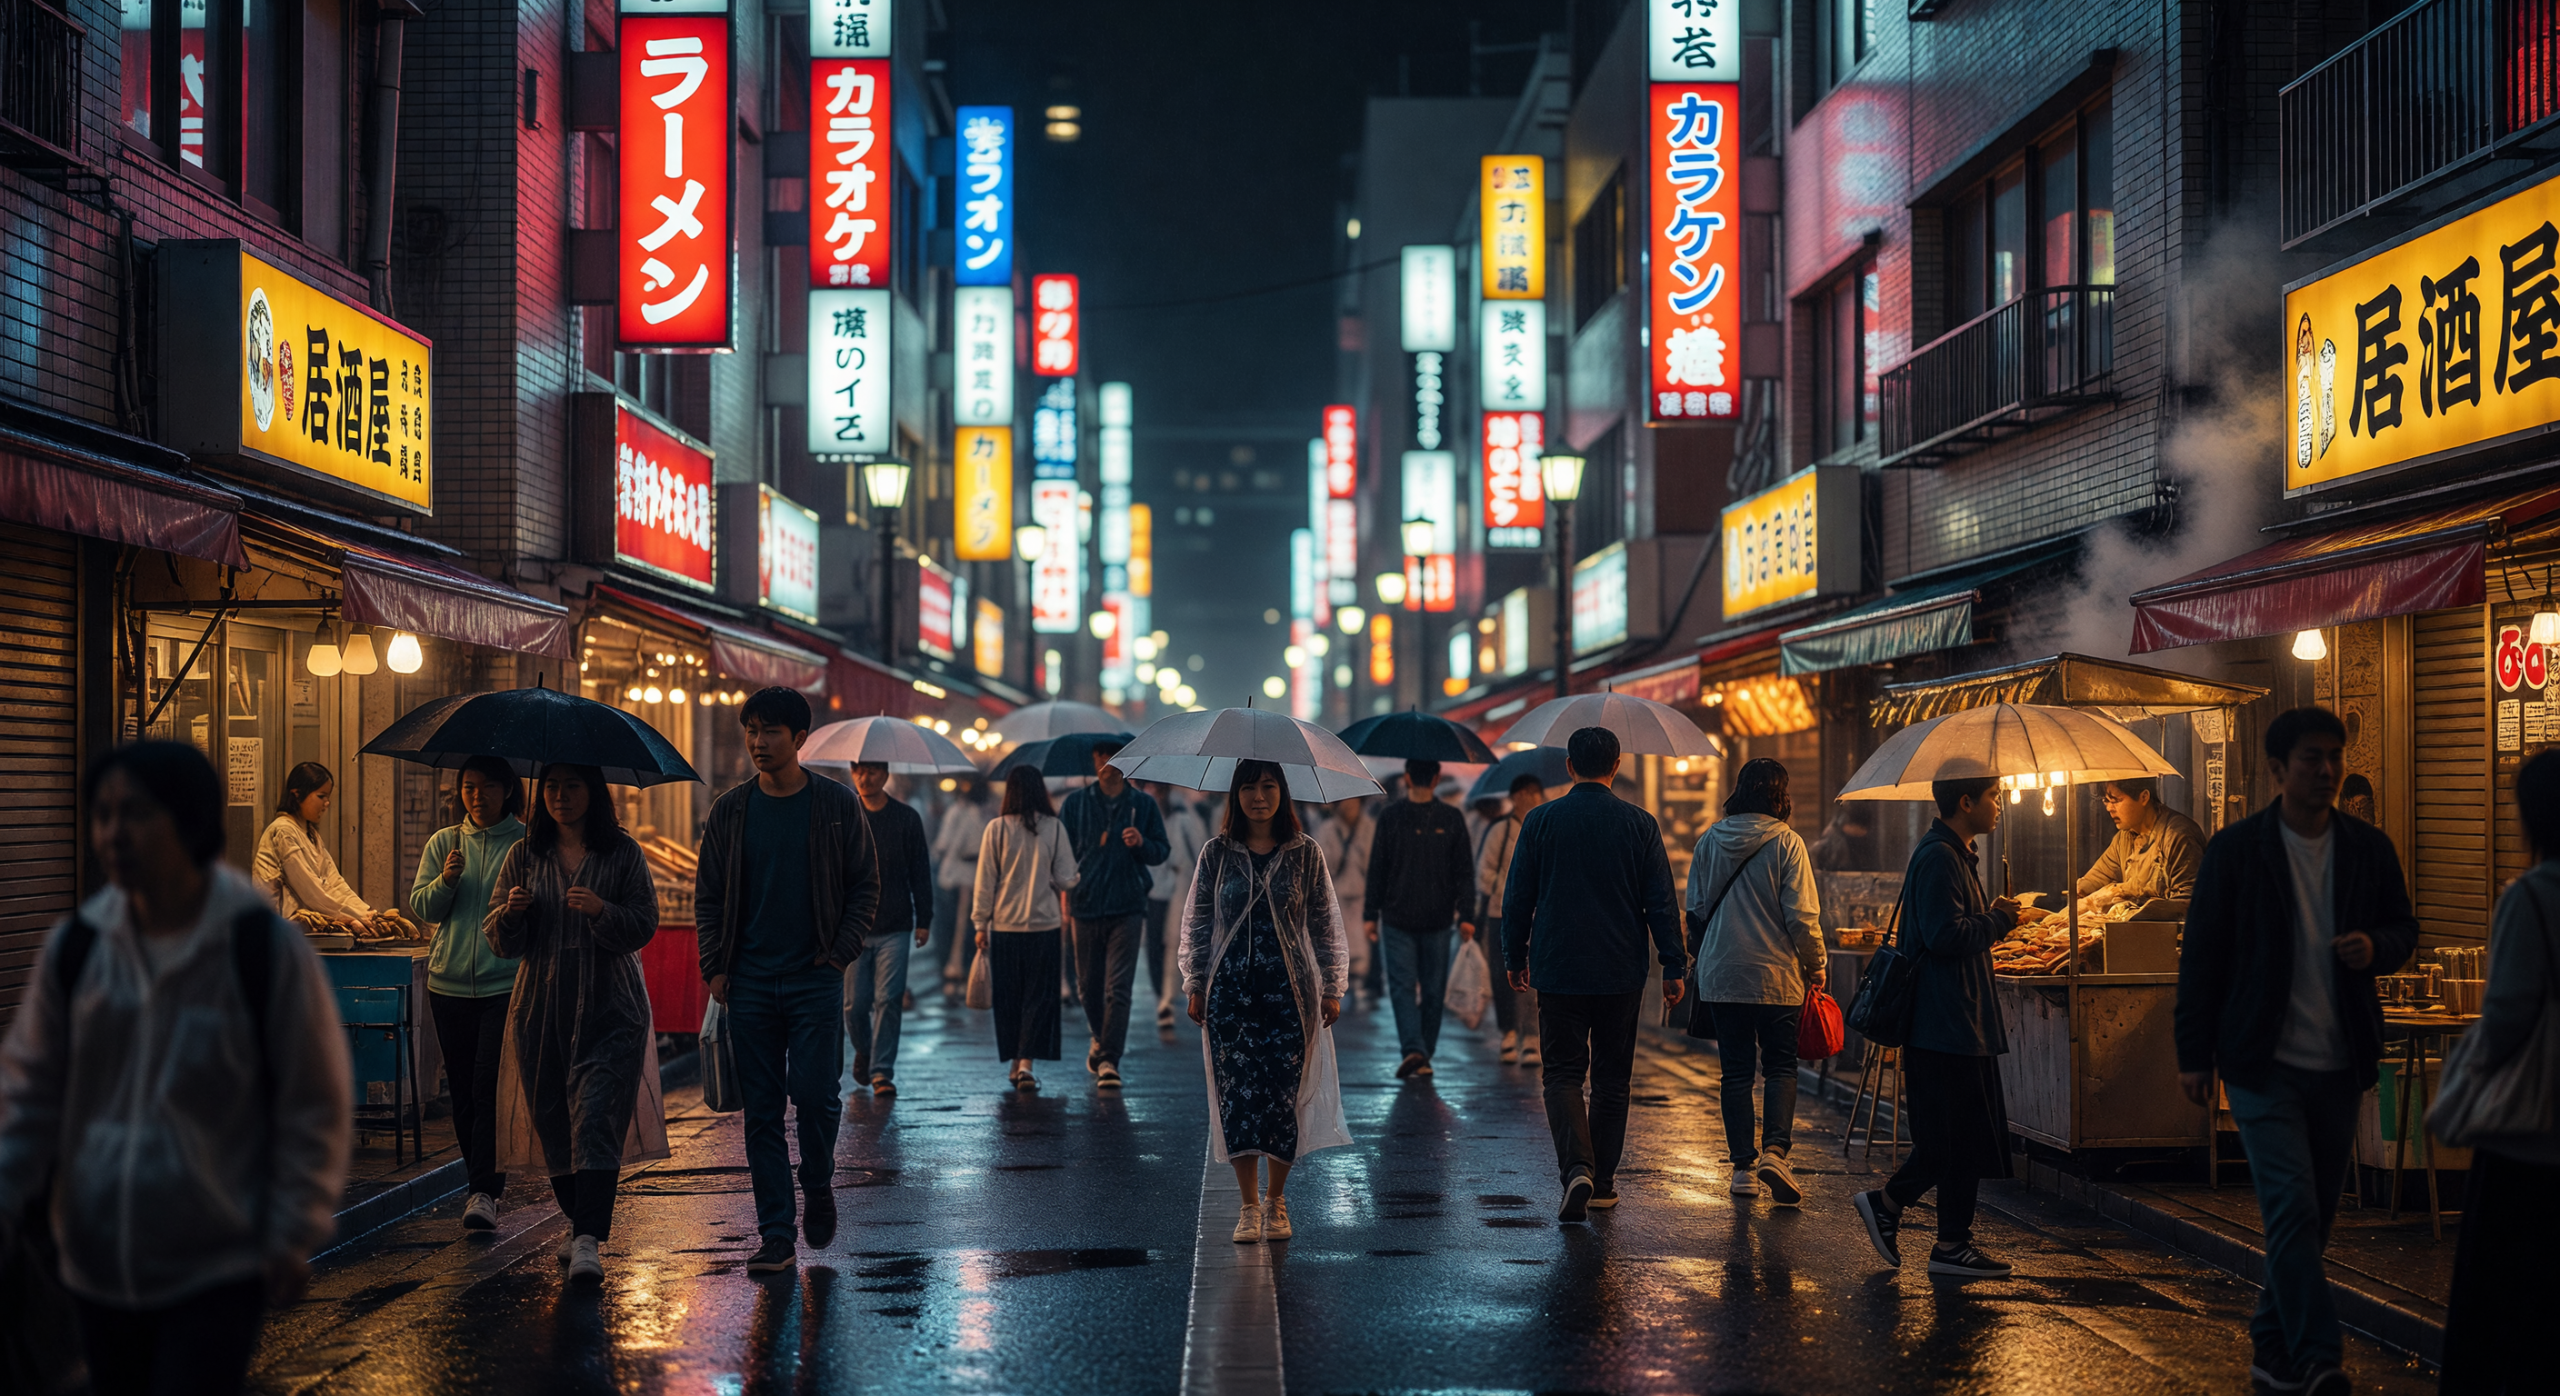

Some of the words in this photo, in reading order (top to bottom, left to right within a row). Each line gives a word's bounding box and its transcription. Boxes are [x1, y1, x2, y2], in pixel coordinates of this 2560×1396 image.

[637, 36, 710, 325] ラーメン
[824, 67, 877, 261] カラオケ
[1664, 92, 1726, 315] カラケン
[302, 323, 391, 467] 居酒屋
[2349, 220, 2560, 440] 居酒屋
